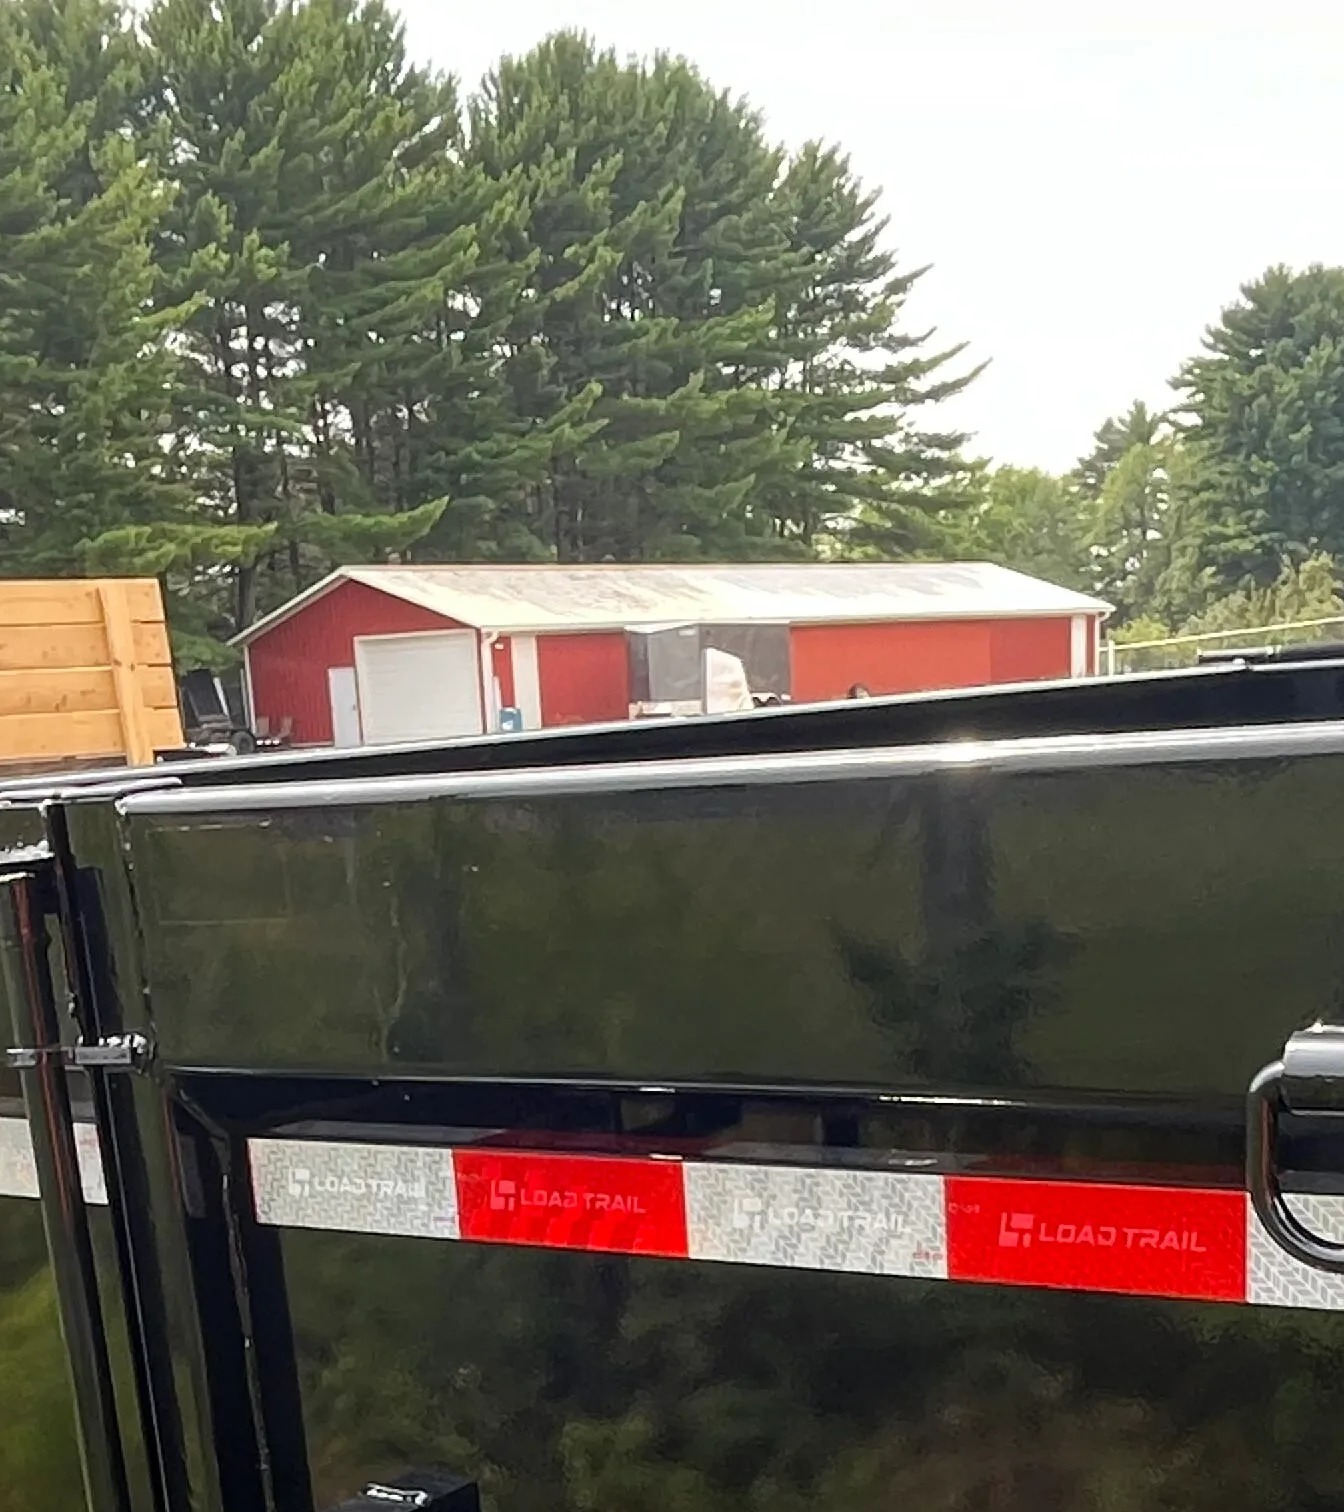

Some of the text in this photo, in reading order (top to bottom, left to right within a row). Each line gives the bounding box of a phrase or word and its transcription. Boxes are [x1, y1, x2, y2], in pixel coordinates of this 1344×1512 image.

[313, 1176, 426, 1198] LOAD TRAIL
[520, 1188, 647, 1214] LOAD TRAIL
[768, 1208, 912, 1232] LOAD TRAIL
[1038, 1222, 1207, 1252] LOAD TRAIL
